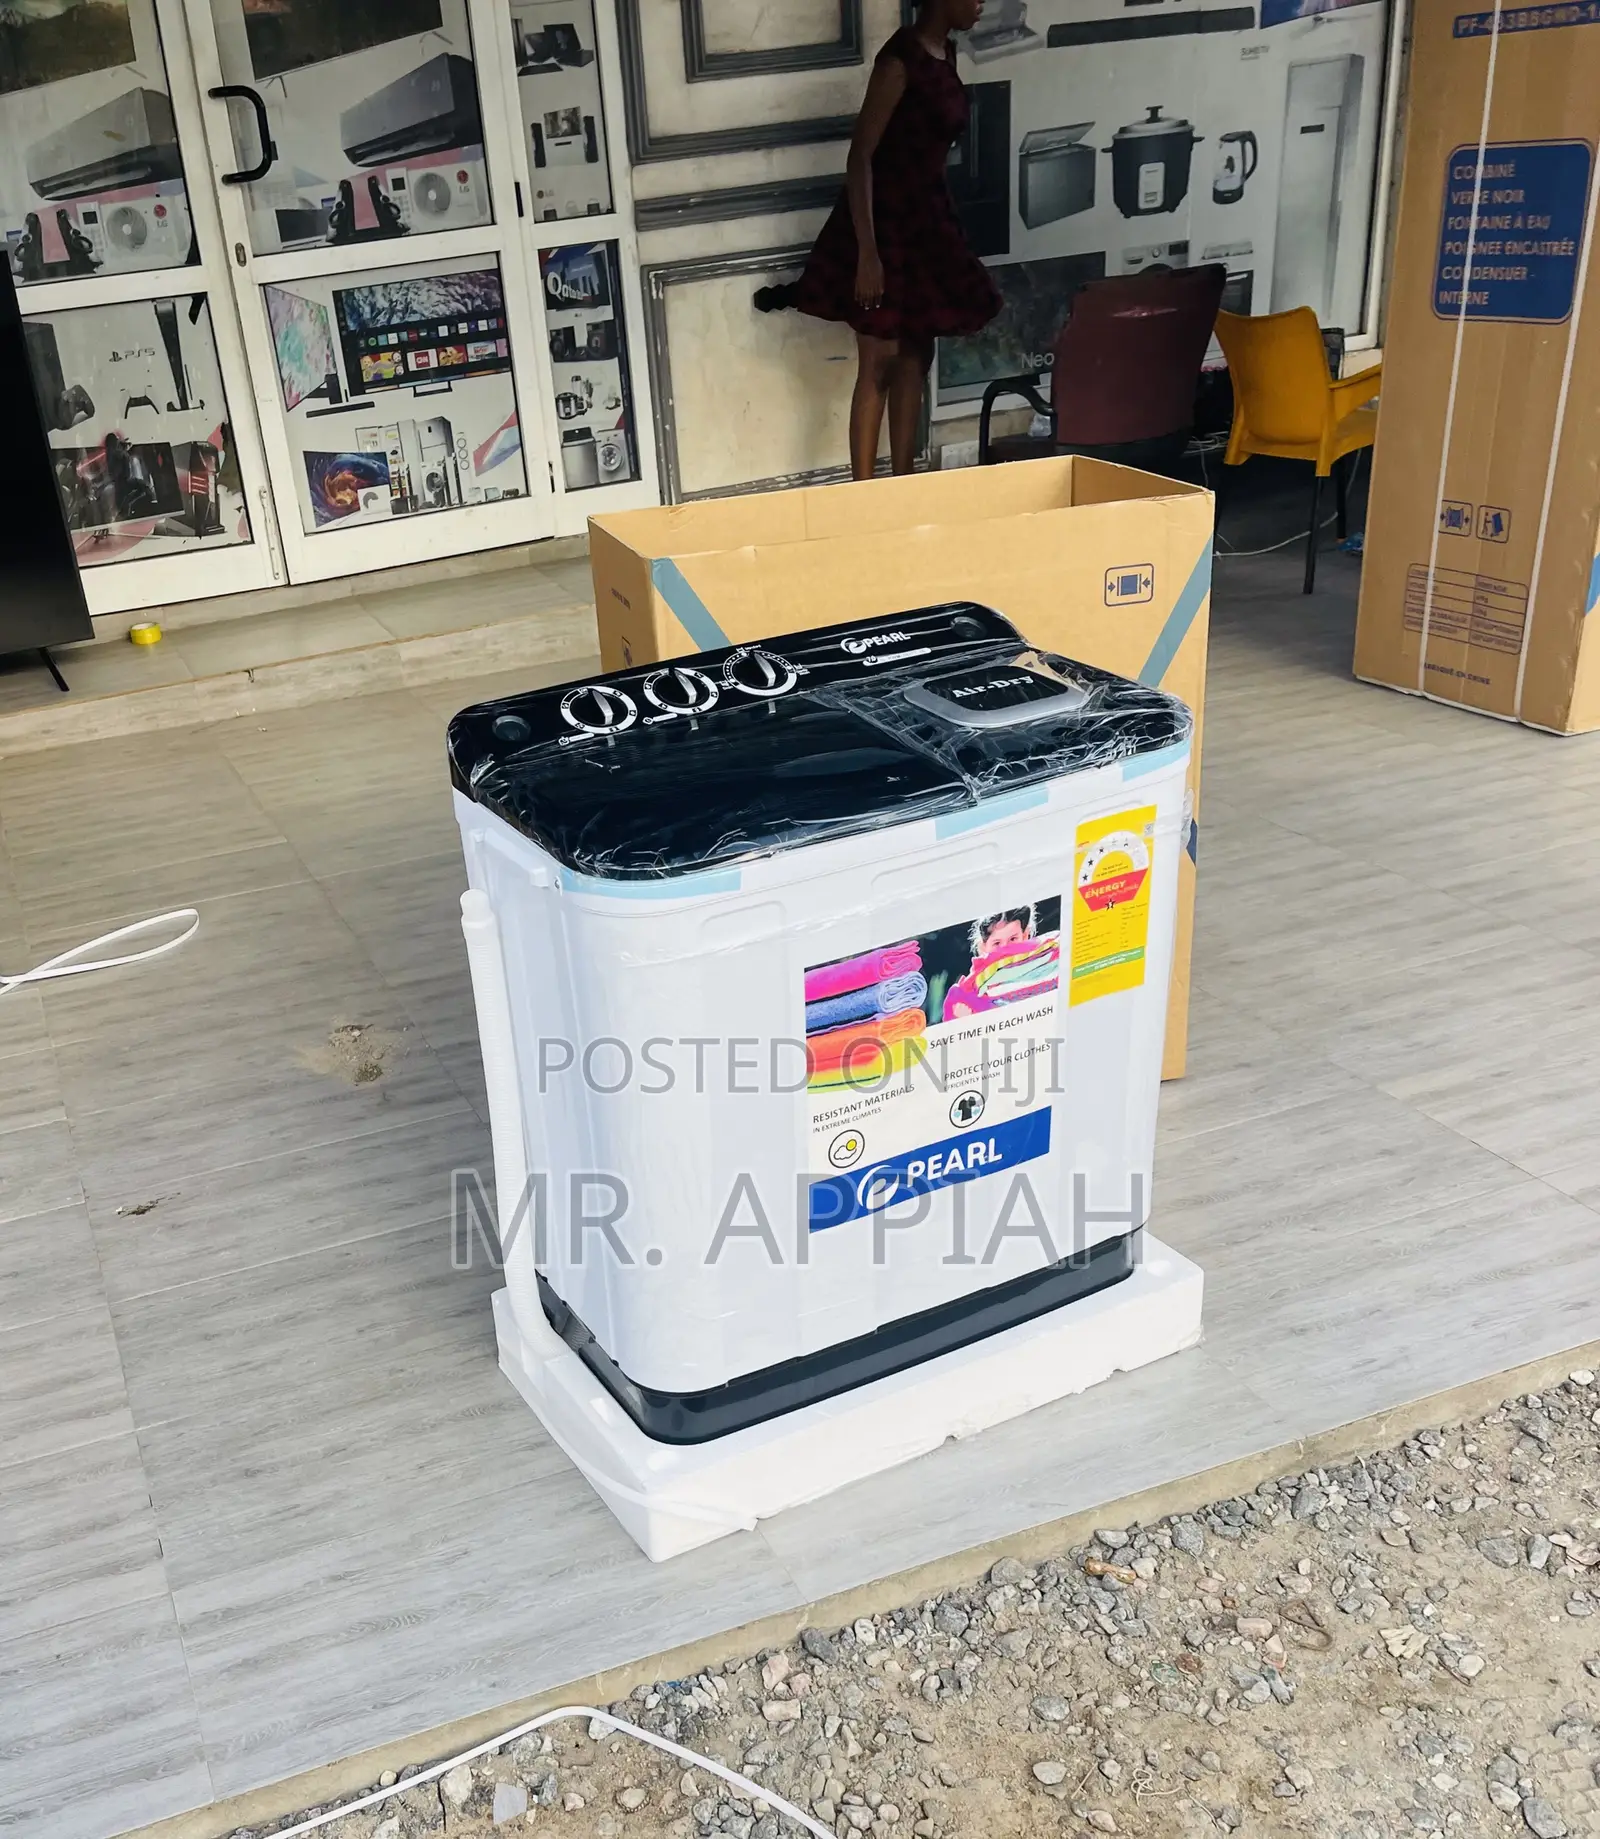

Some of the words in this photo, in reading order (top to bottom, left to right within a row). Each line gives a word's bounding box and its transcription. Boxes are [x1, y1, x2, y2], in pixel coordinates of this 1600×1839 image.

[1492, 189, 1525, 204] NOIR
[1021, 351, 1055, 369] Neo
[862, 631, 911, 648] PEARL
[952, 676, 1034, 698] Air-Dry
[1084, 880, 1126, 899] ENERGY
[930, 1034, 955, 1050] SAVE
[958, 1027, 982, 1042] TIME
[985, 1023, 996, 1034] IN
[998, 1015, 1024, 1031] EACH
[1025, 1005, 1054, 1021] WASH
[944, 1063, 985, 1081] PROTECT
[987, 1055, 1012, 1069] YOUR
[1014, 1042, 1051, 1062] CLOTHES
[943, 1075, 980, 1092] EFFICIENTLY
[982, 1071, 1001, 1081] WASH
[813, 1101, 862, 1124] RESISTANT
[864, 1084, 915, 1107] MATERIALS
[812, 1126, 821, 1134] IN
[821, 1116, 851, 1132] EXTREME
[852, 1106, 882, 1122] CLIMATES
[907, 1137, 1003, 1188] PEARL
